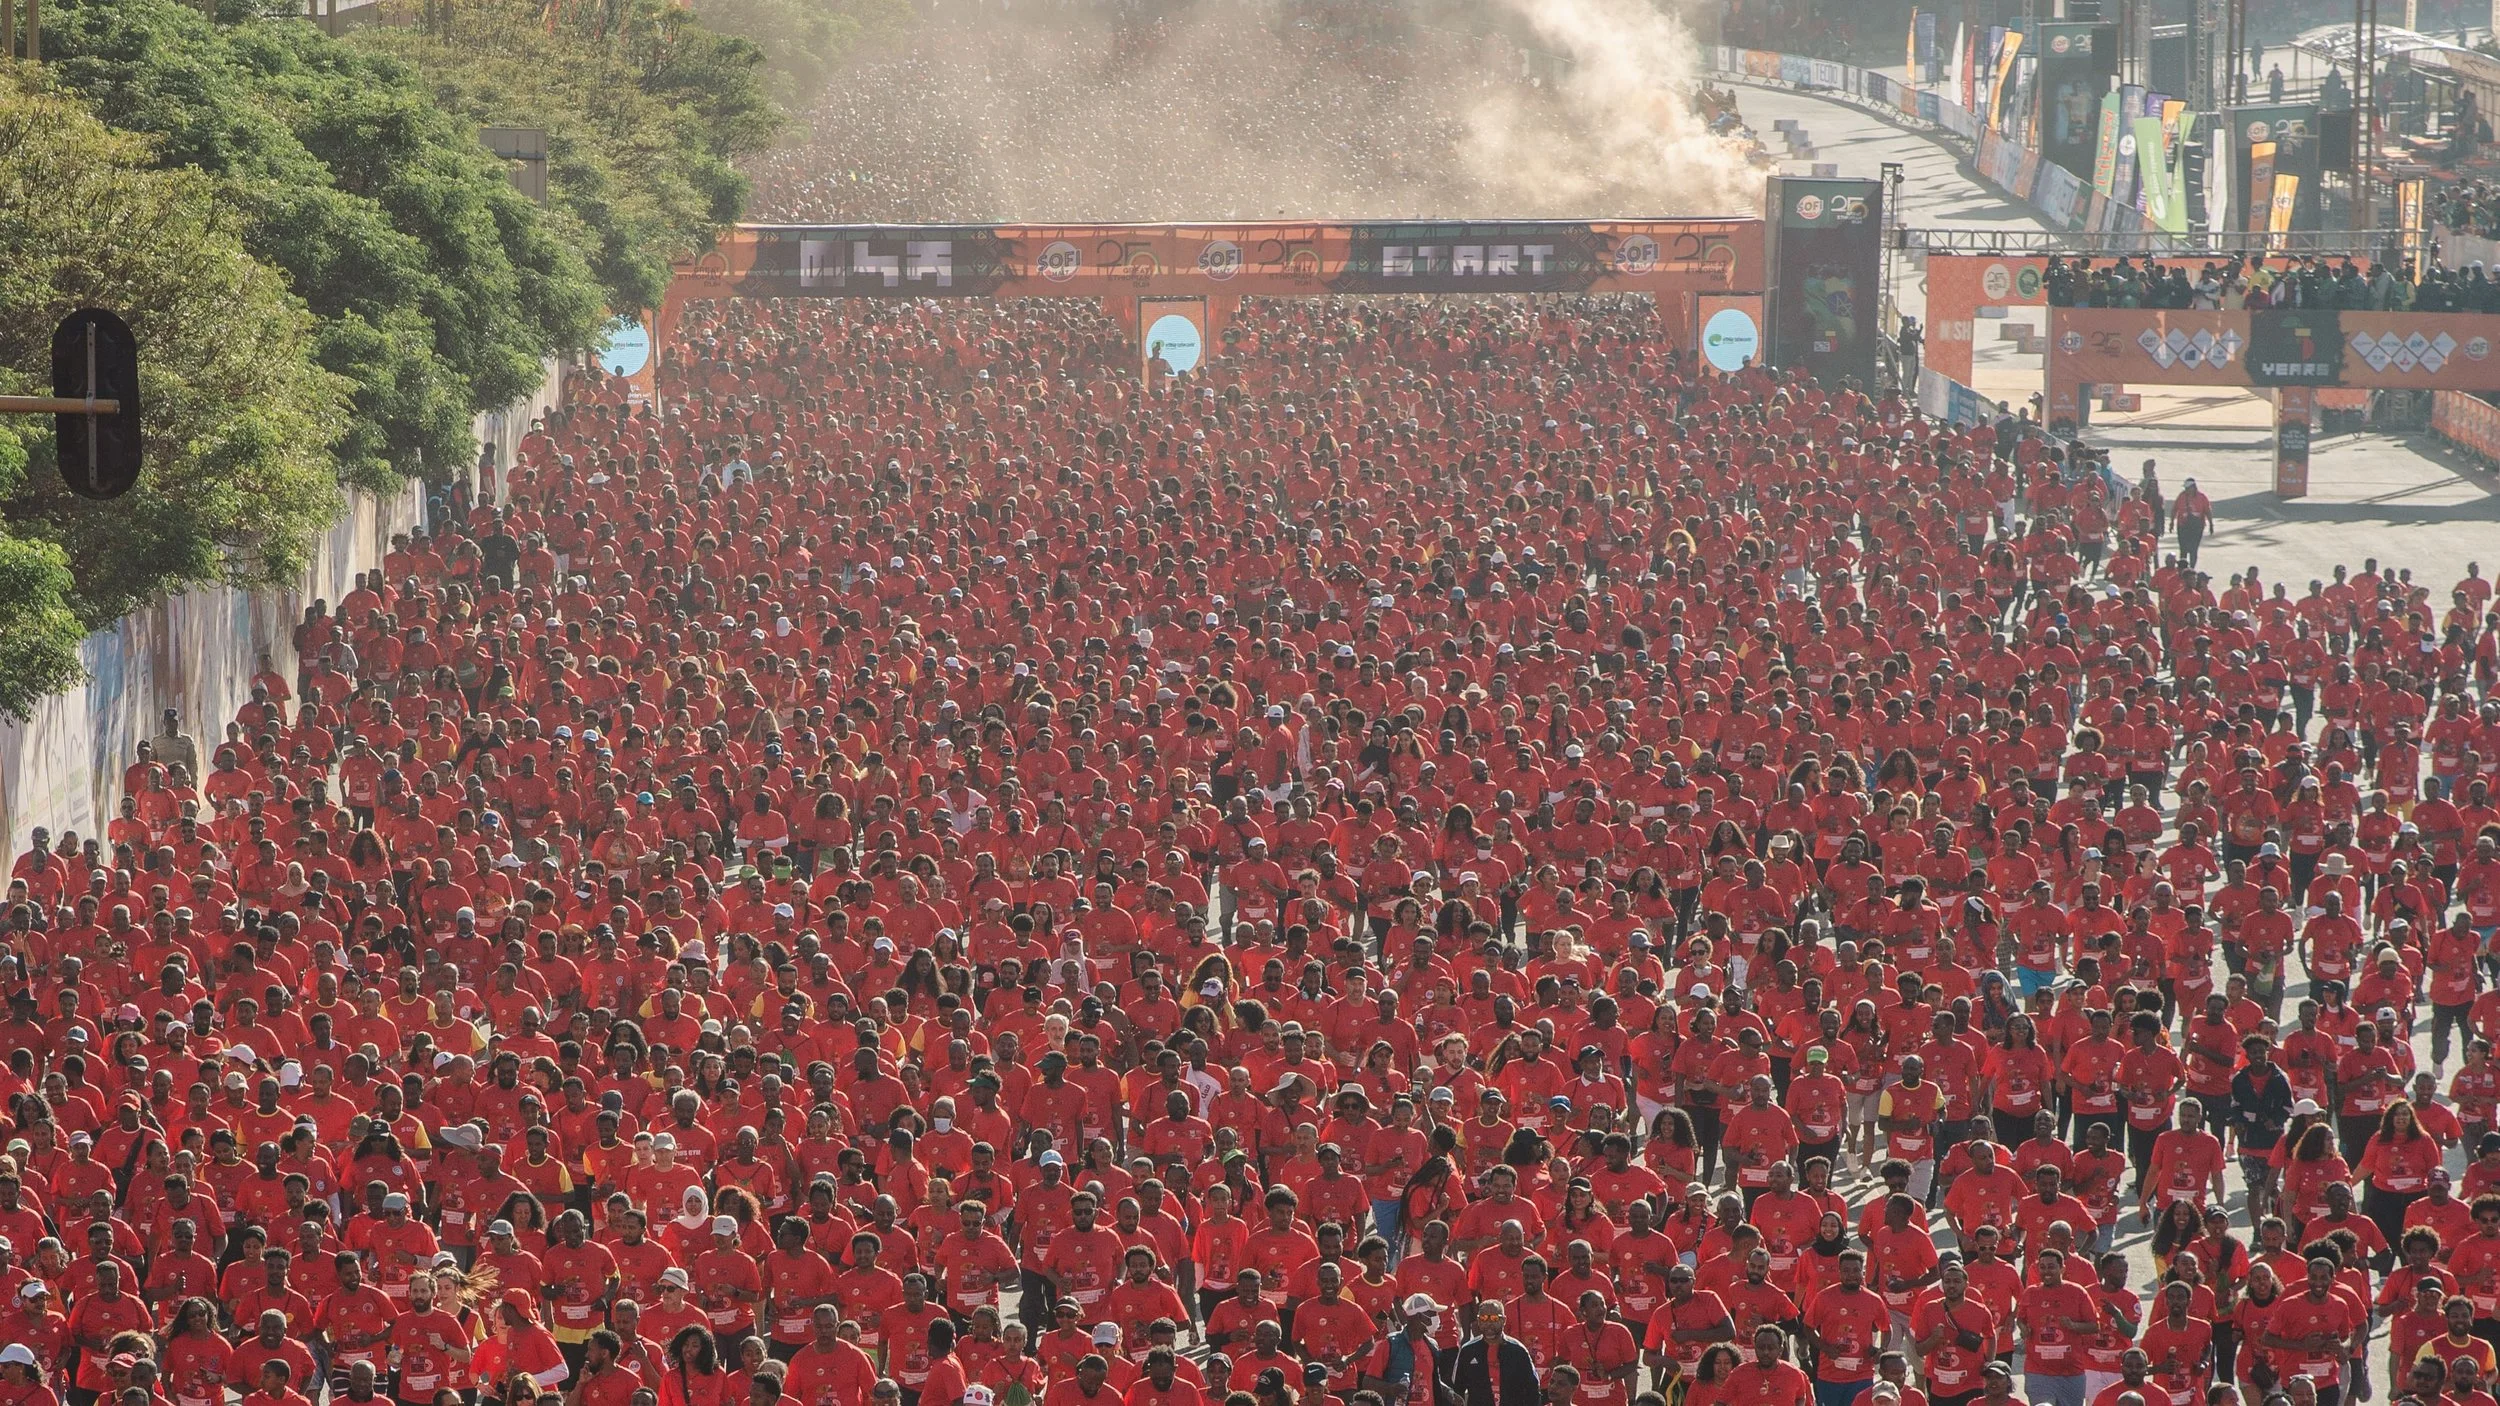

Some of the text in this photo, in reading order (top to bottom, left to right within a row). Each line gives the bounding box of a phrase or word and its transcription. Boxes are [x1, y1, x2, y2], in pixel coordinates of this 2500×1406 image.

[1831, 195, 1869, 217] 25
[1037, 248, 1082, 272] SOFI
[1096, 239, 1161, 274] 25
[1198, 248, 1243, 271] SOFI
[1258, 239, 1323, 273] 25
[1382, 245, 1554, 276] START
[1614, 242, 1659, 265] SOFI
[1674, 232, 1739, 267] 25
[1132, 281, 1151, 289] RUN
[2058, 335, 2083, 347] SOFI
[2091, 331, 2124, 354] 25
[2262, 363, 2330, 376] YEARS
